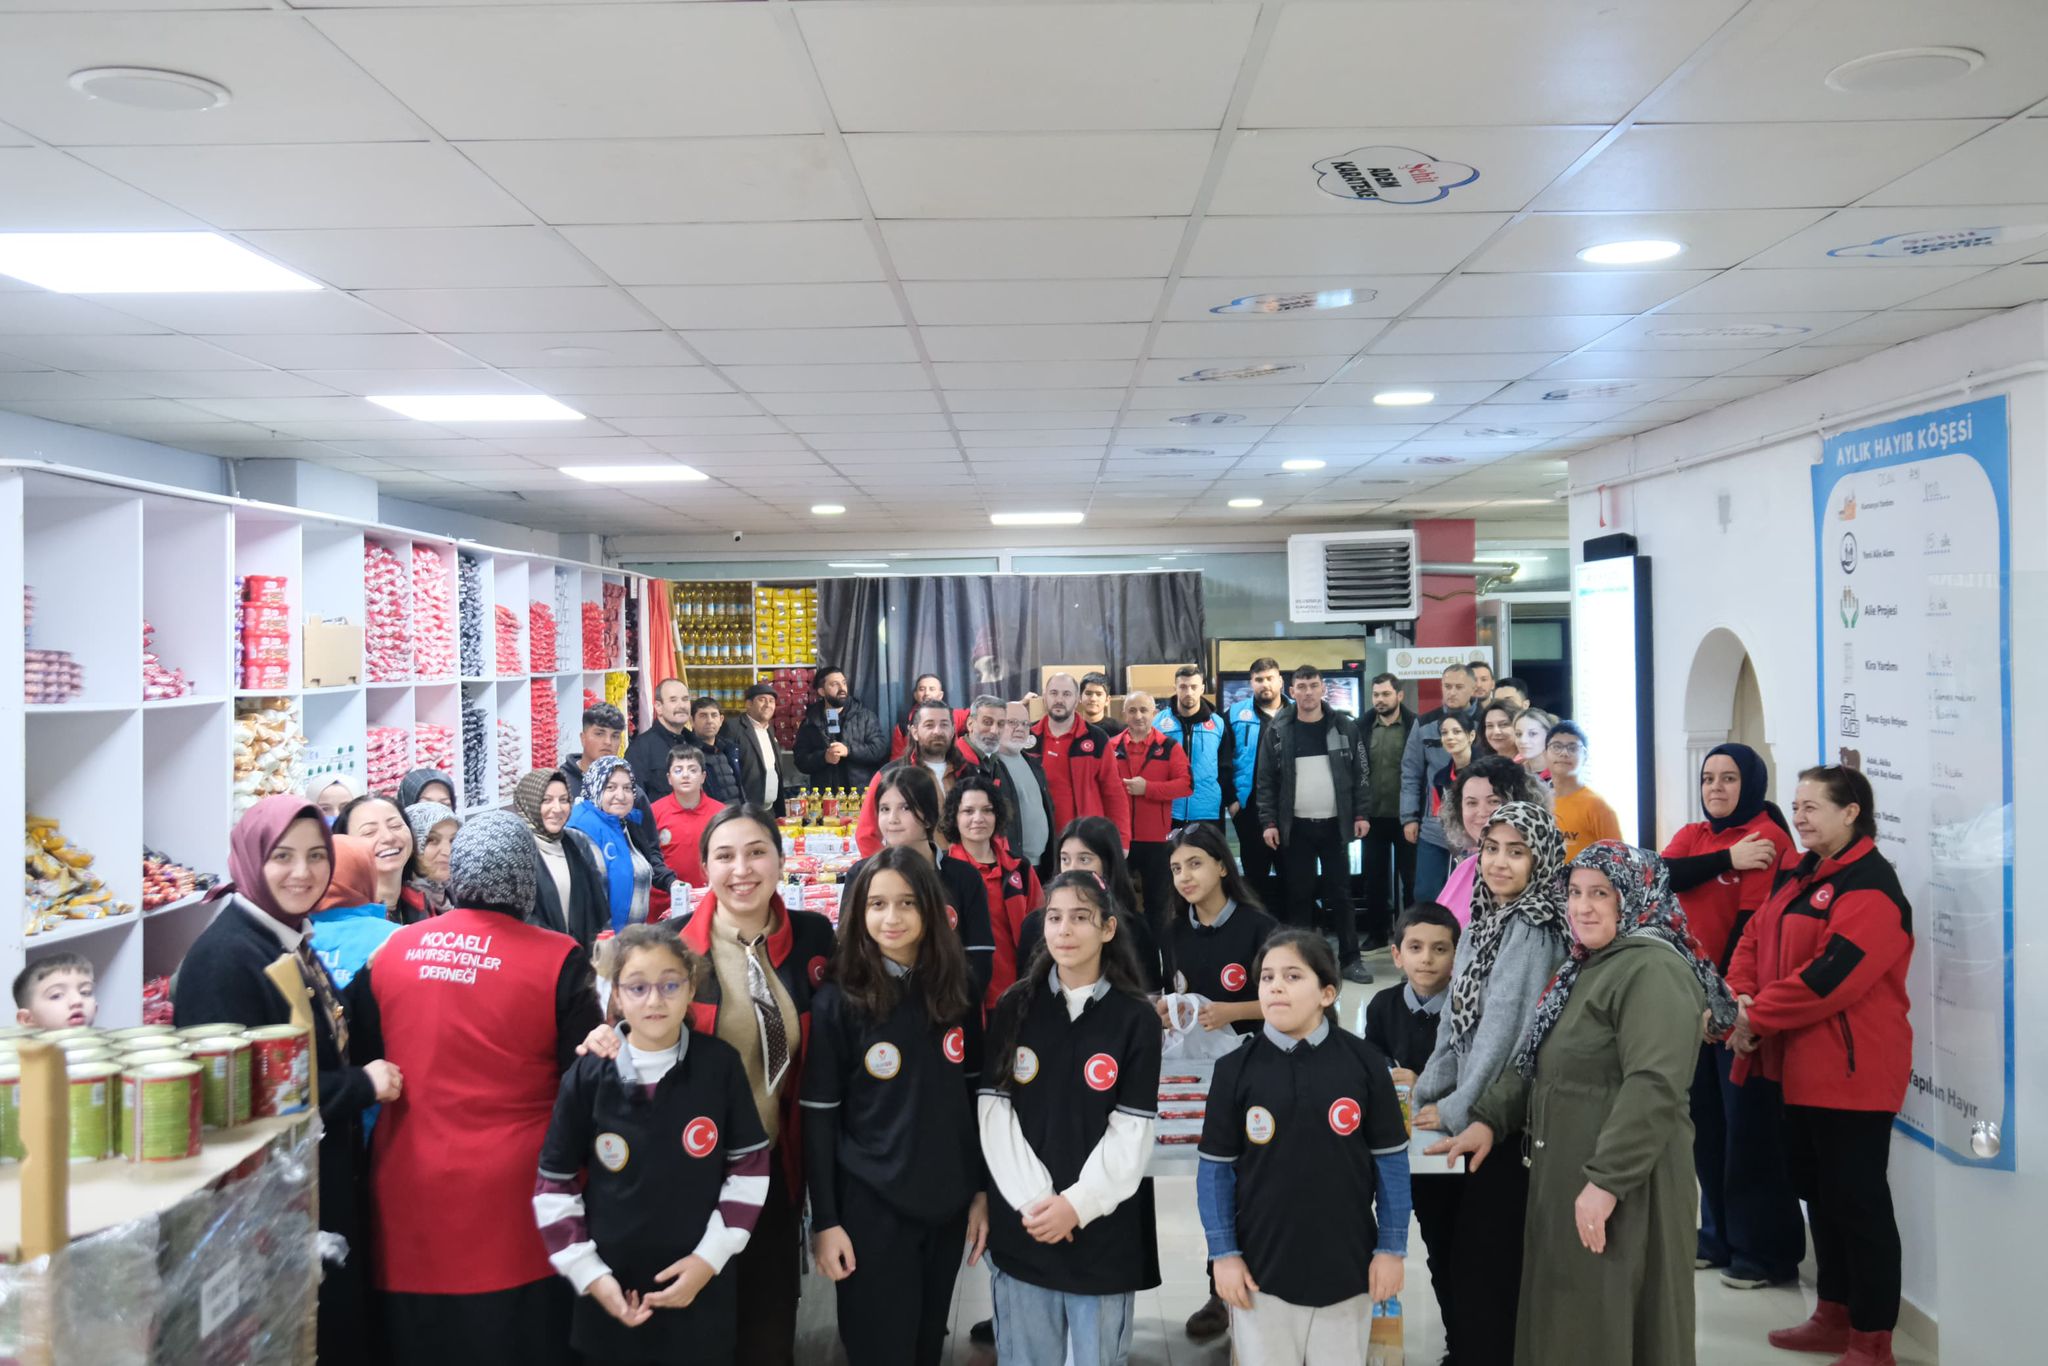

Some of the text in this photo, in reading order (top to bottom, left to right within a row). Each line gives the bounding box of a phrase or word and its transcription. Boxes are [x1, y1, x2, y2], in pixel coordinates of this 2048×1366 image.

[1331, 162, 1379, 198] KARATEKE
[1367, 168, 1402, 188] ADEM
[1836, 412, 1973, 466] AYLIK HAYIR KÖŞESİ
[1864, 604, 1898, 618] Aile Projesi
[1417, 654, 1464, 665] KOCAELİ
[1865, 660, 1877, 671] Kira
[420, 931, 493, 954] KOCAELİ
[405, 949, 501, 971] HAYIRSEVENLER
[419, 965, 477, 984] DERNEĞİ
[1947, 1087, 1978, 1119] Hayır
